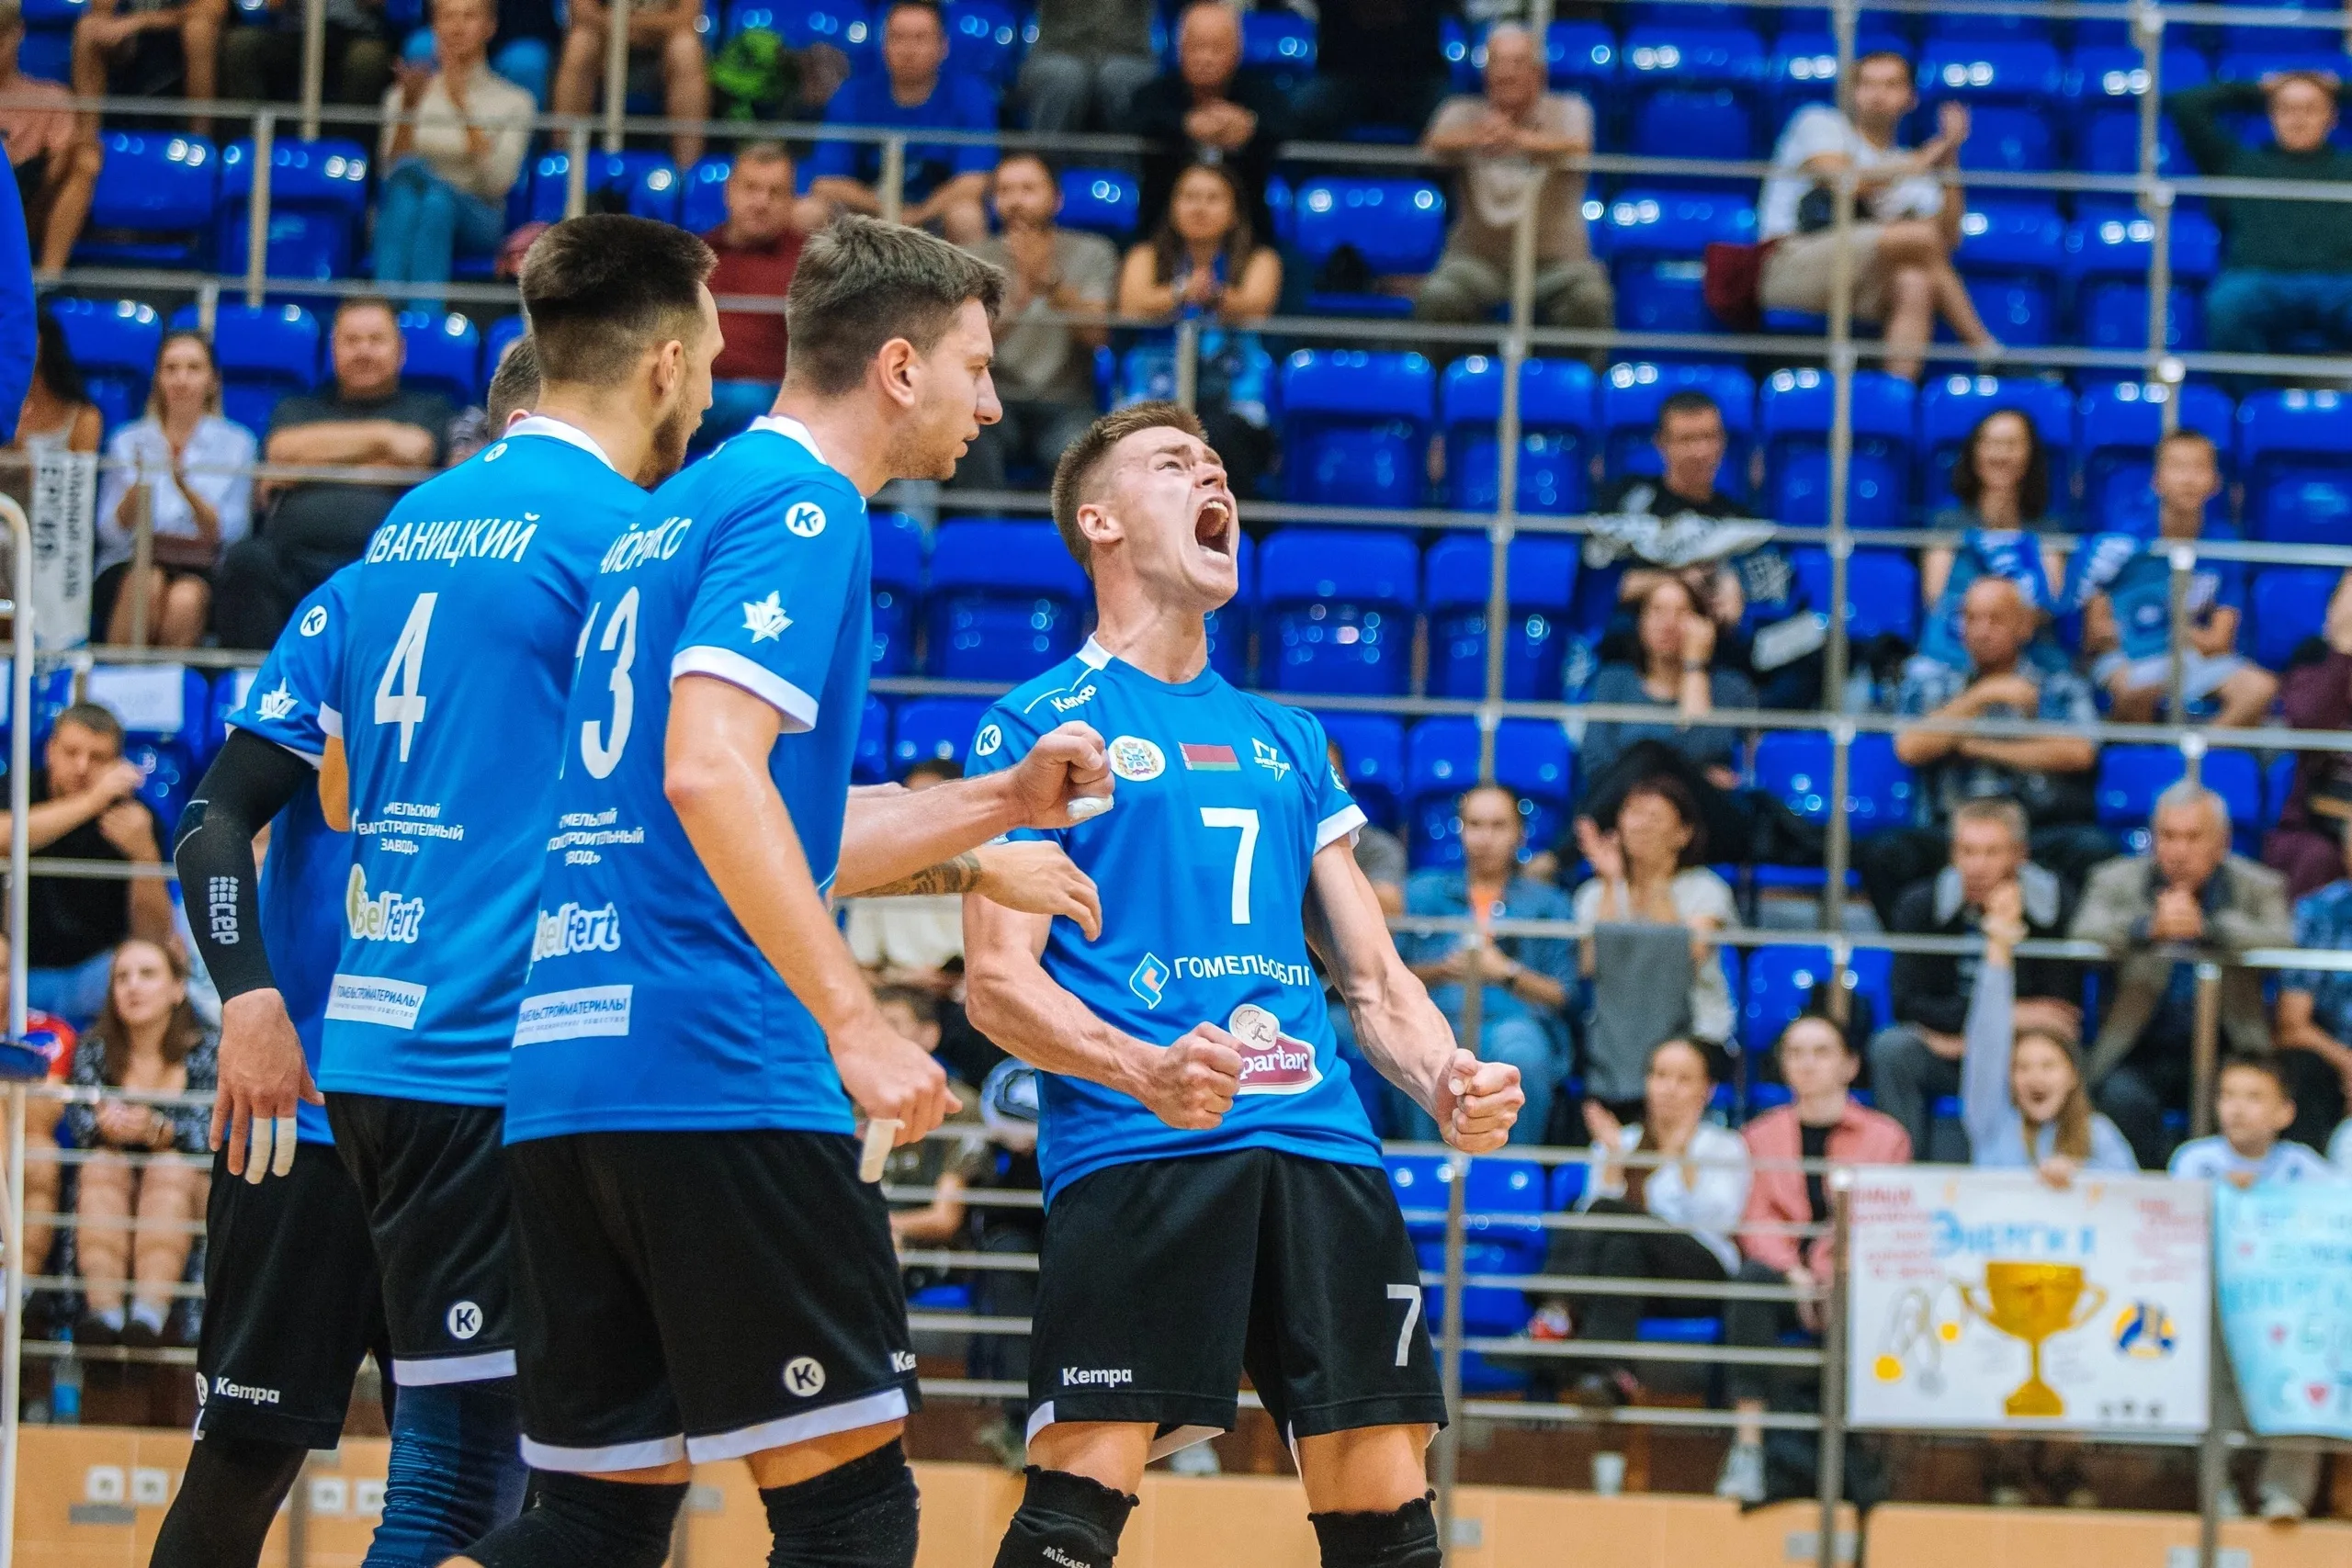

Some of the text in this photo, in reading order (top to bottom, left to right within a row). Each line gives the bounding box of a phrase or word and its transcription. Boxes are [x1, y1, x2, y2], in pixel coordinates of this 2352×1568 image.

[365, 512, 541, 568] ИВАНИЦКИЙ
[375, 592, 438, 761] 4
[1200, 807, 1261, 925] 7
[1240, 1044, 1308, 1080] partak
[1386, 1283, 1421, 1367] 7
[214, 1377, 280, 1405] Kempa
[1062, 1366, 1133, 1388] Kempa
